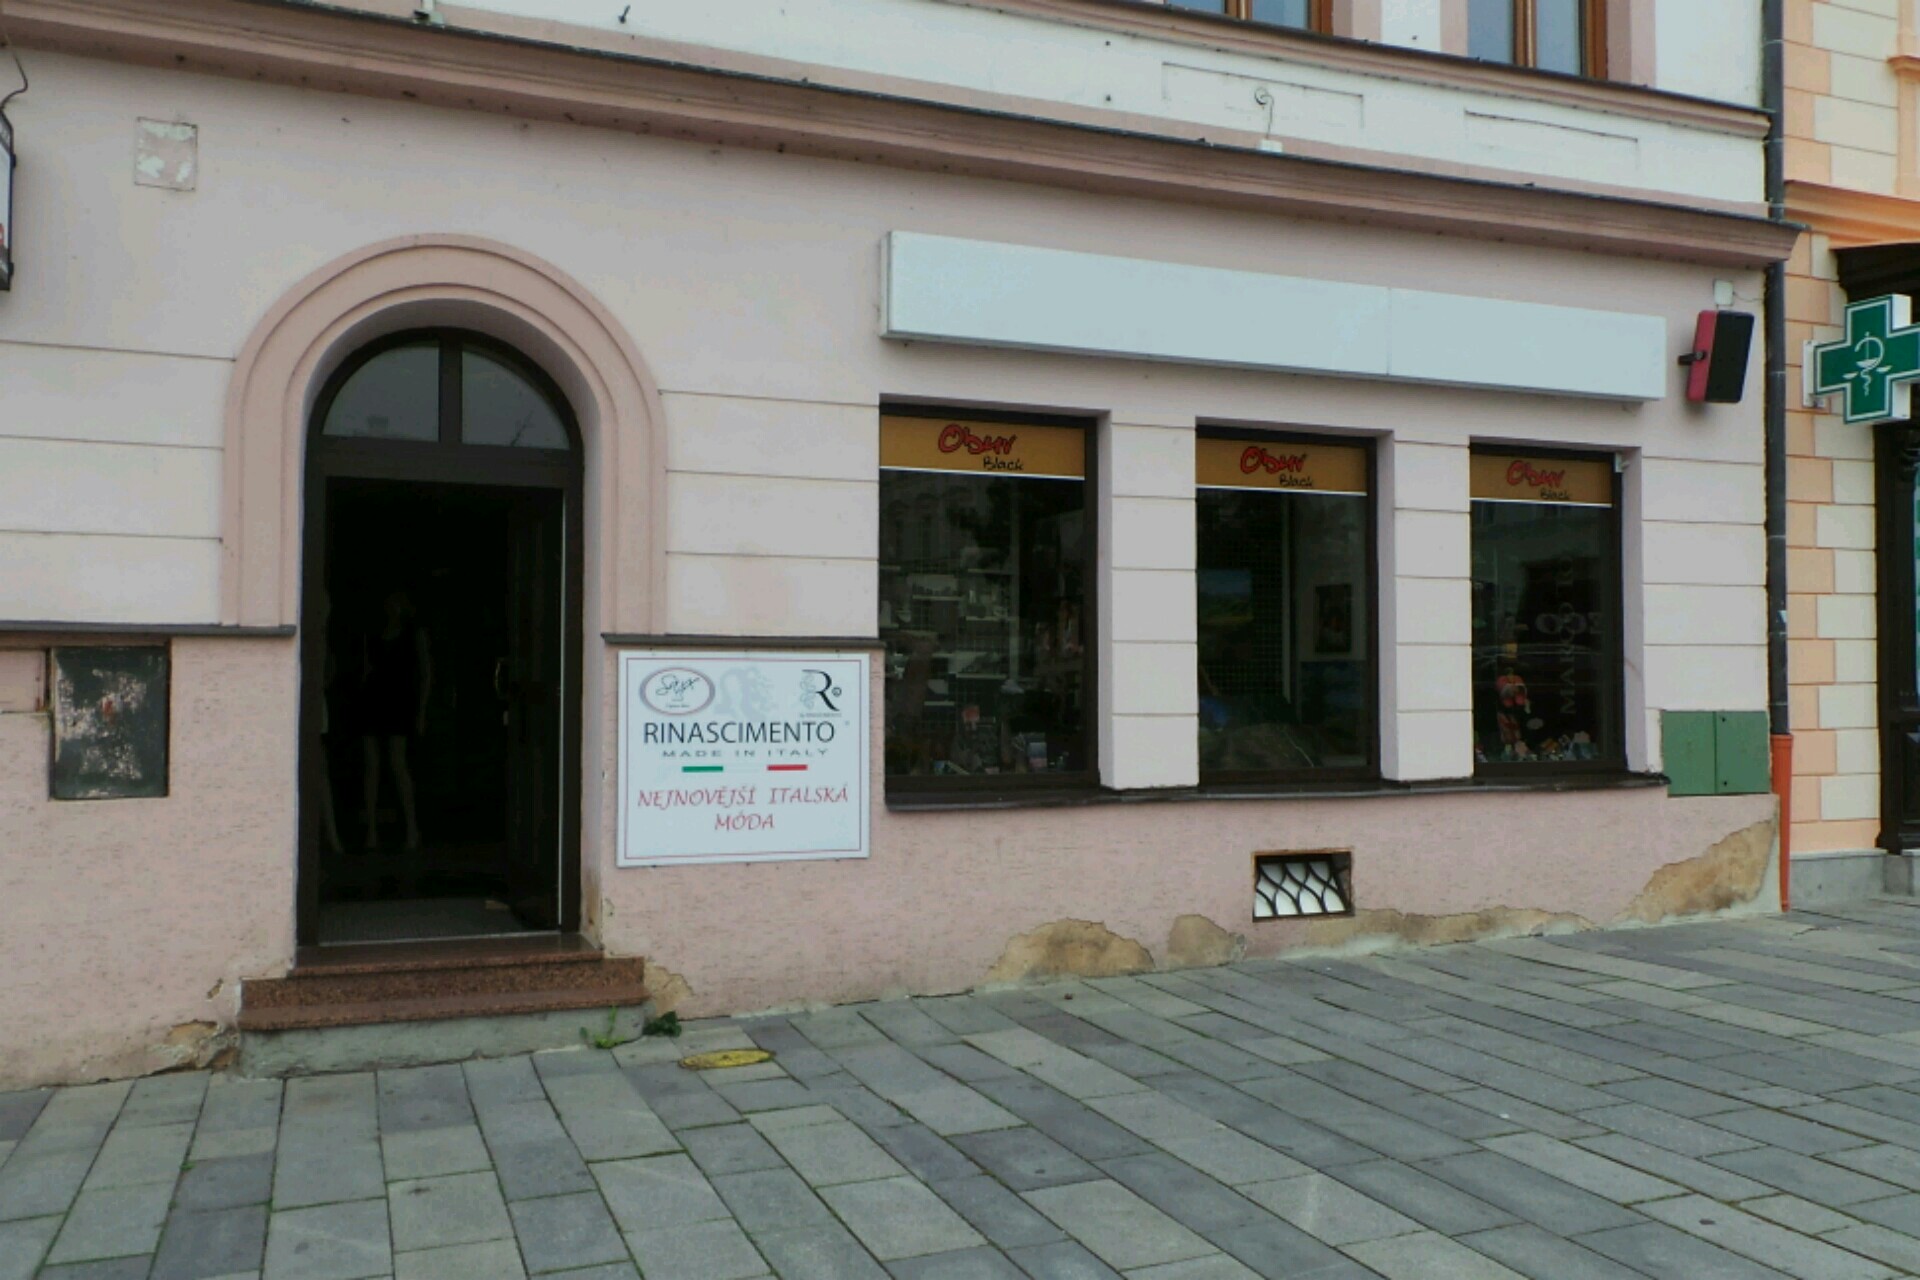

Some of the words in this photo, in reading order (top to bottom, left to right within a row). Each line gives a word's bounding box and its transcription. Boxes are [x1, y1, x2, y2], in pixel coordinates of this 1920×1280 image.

[983, 456, 1023, 471] Black
[643, 720, 835, 744] RINASCIMENTO
[662, 749, 722, 757] MADE
[735, 749, 756, 757] IN
[767, 748, 829, 757] ITALY
[637, 785, 756, 810] NEJNOVĚJŠÍ
[768, 783, 849, 805] ITALSKÁ
[714, 810, 775, 831] MÓDA
